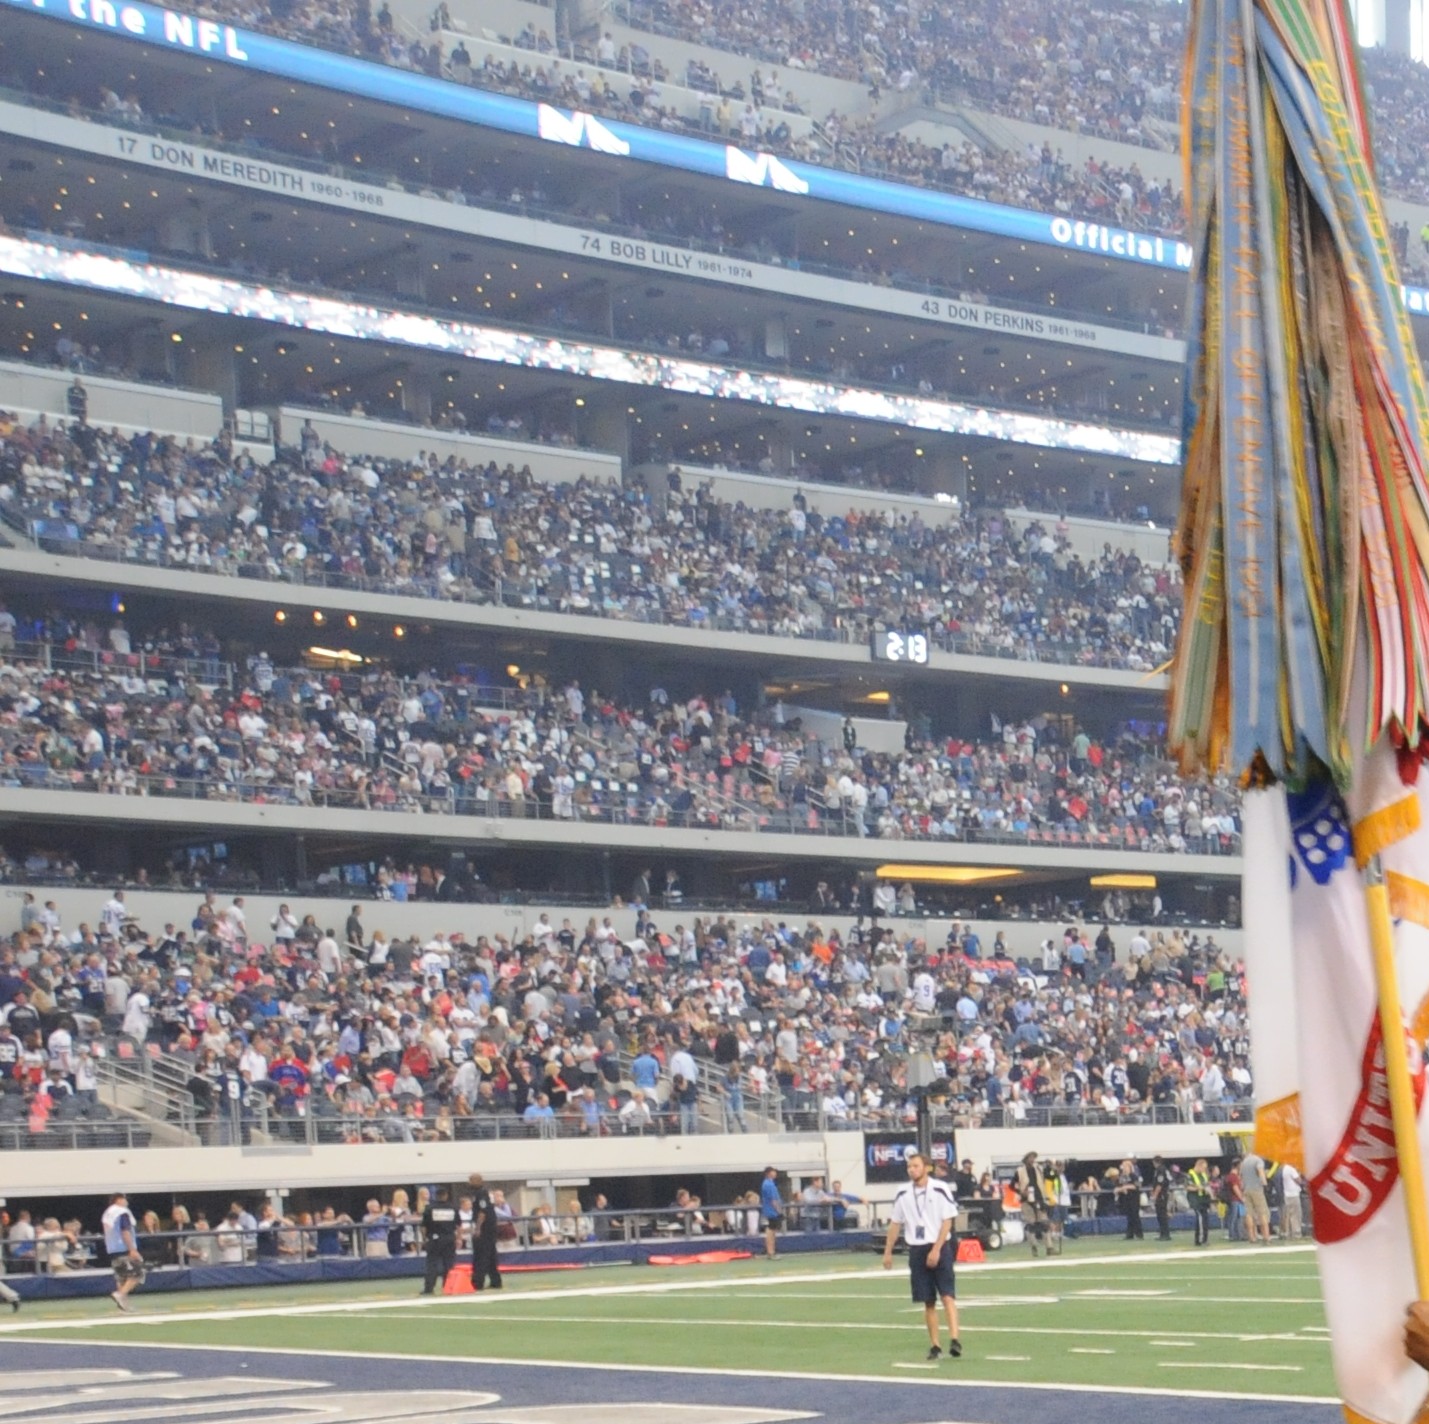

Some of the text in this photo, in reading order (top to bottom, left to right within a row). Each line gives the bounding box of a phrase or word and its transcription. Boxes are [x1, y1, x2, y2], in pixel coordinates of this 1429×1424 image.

[164, 11, 248, 61] NFL
[118, 136, 384, 208] 17 DON MEREDITH 1960-1968
[580, 235, 753, 279] 74 BOB LILLY 1961-1974
[1052, 217, 1164, 263] Official
[921, 300, 940, 315] 43
[948, 304, 979, 322] DON
[985, 311, 1044, 333] PERKINS
[873, 1149, 904, 1162] NFL
